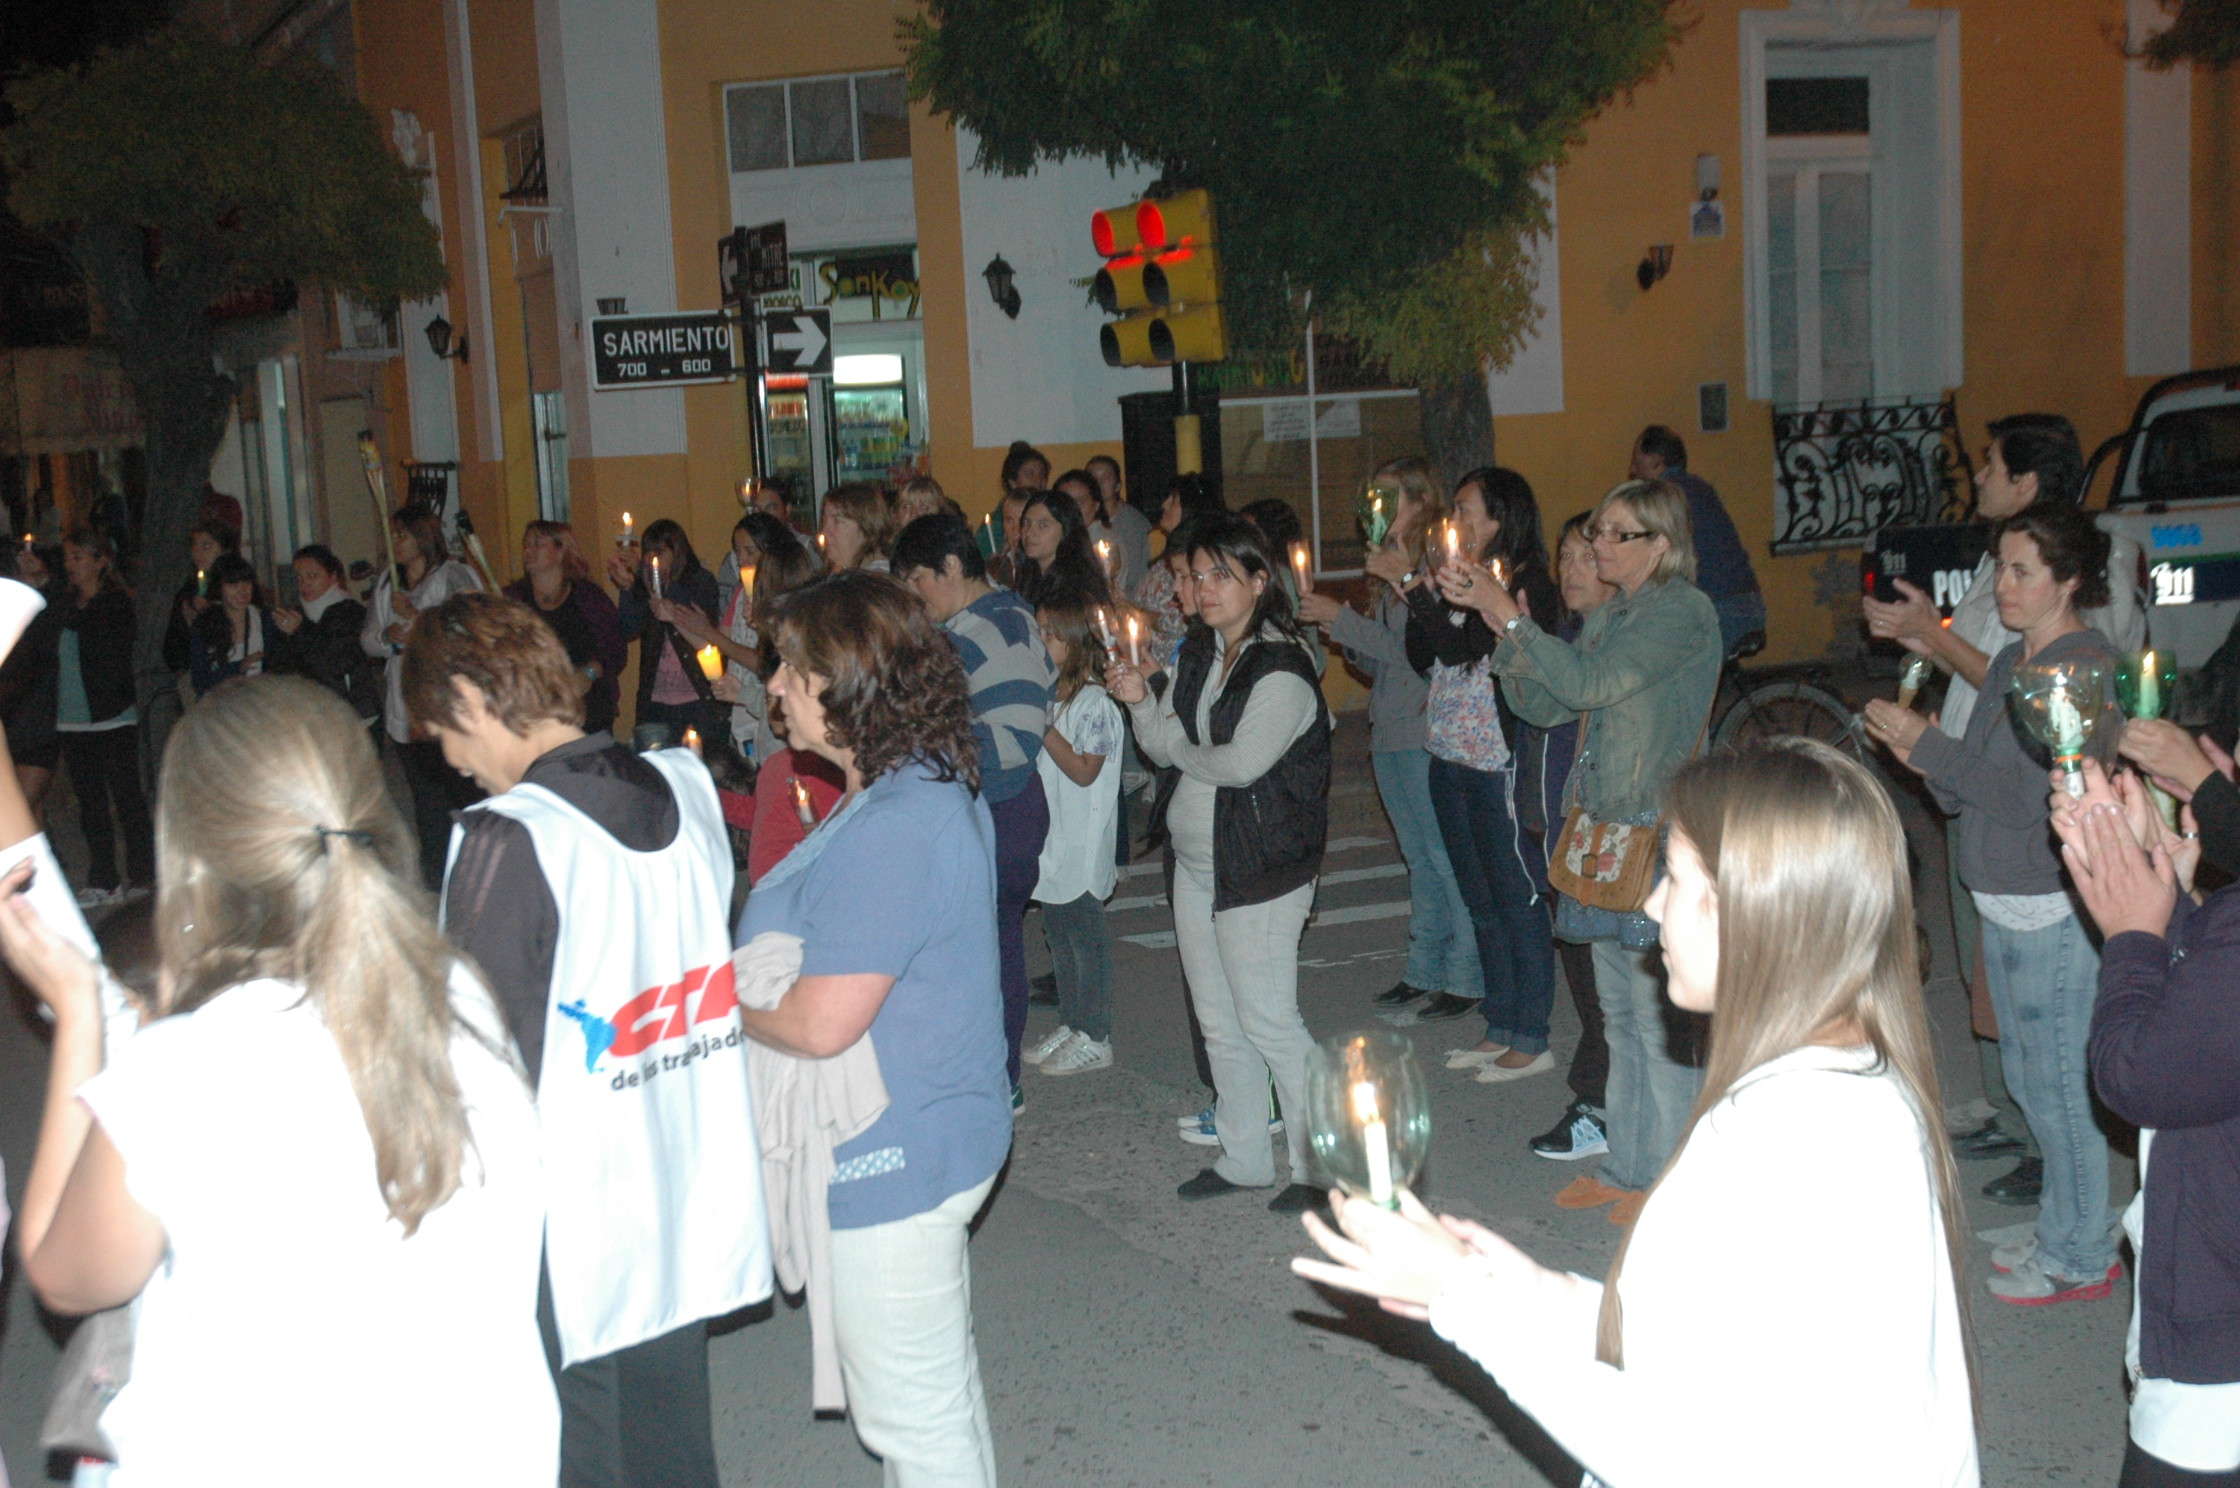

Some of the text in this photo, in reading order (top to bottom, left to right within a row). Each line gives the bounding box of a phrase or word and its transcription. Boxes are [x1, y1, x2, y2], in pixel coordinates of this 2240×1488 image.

[603, 326, 730, 357] SARMIENTO
[618, 362, 647, 377] 700
[682, 359, 711, 374] 600
[2155, 564, 2194, 597] 911
[611, 1069, 640, 1092] de
